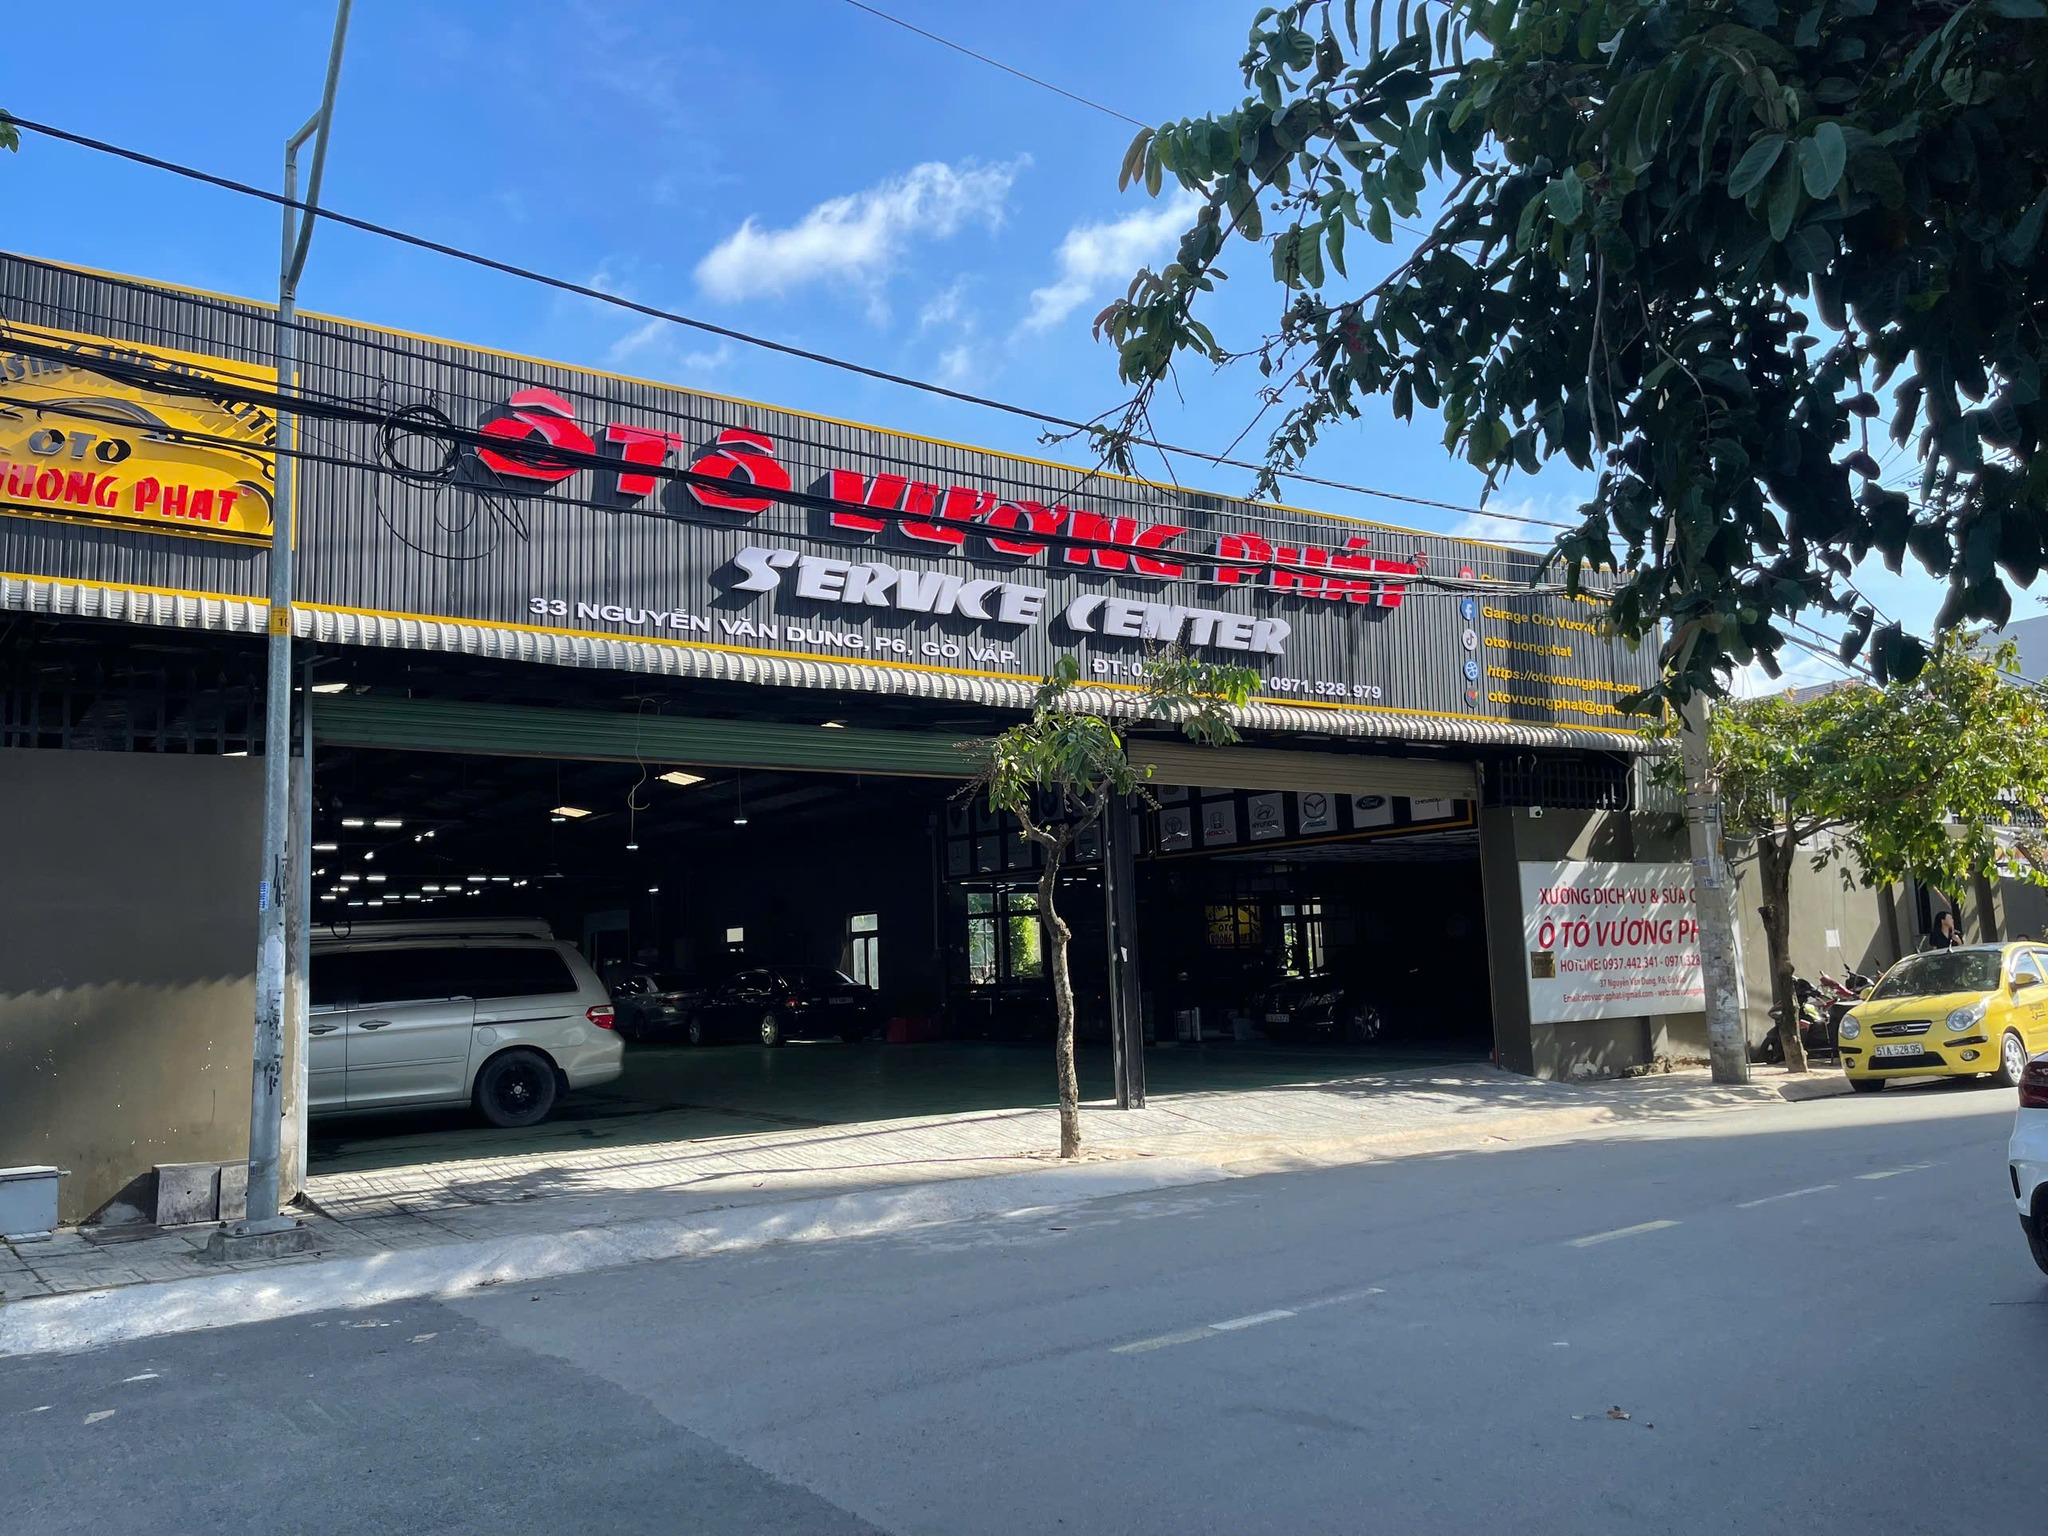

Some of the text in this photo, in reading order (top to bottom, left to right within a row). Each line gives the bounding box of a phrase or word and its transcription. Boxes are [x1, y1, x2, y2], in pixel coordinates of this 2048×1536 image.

[28, 428, 132, 464] OTO
[134, 476, 238, 523] PHAT
[830, 468, 1418, 608] VƯƠNG PHÁT
[731, 546, 1292, 655] SERVICE CENTER
[529, 597, 1022, 666] 33 NGUYỄN VĂN DUNG, P6, GÒ VẤP.
[1482, 605, 1529, 625] Garage
[1531, 613, 1555, 628] Oto
[1484, 637, 1572, 658] otovuongphat
[1270, 675, 1382, 700] 0971.328.979
[1486, 664, 1642, 695] https://otovuongphat.com
[1540, 881, 1591, 906] XƯỞNG
[1594, 887, 1626, 909] DỊCH
[1629, 887, 1647, 909] VỤ
[1650, 888, 1660, 904] &
[1596, 916, 1673, 947] VƯƠNG
[1560, 957, 1602, 973] HOTLINE:
[1602, 956, 1659, 971] 0937.442.341
